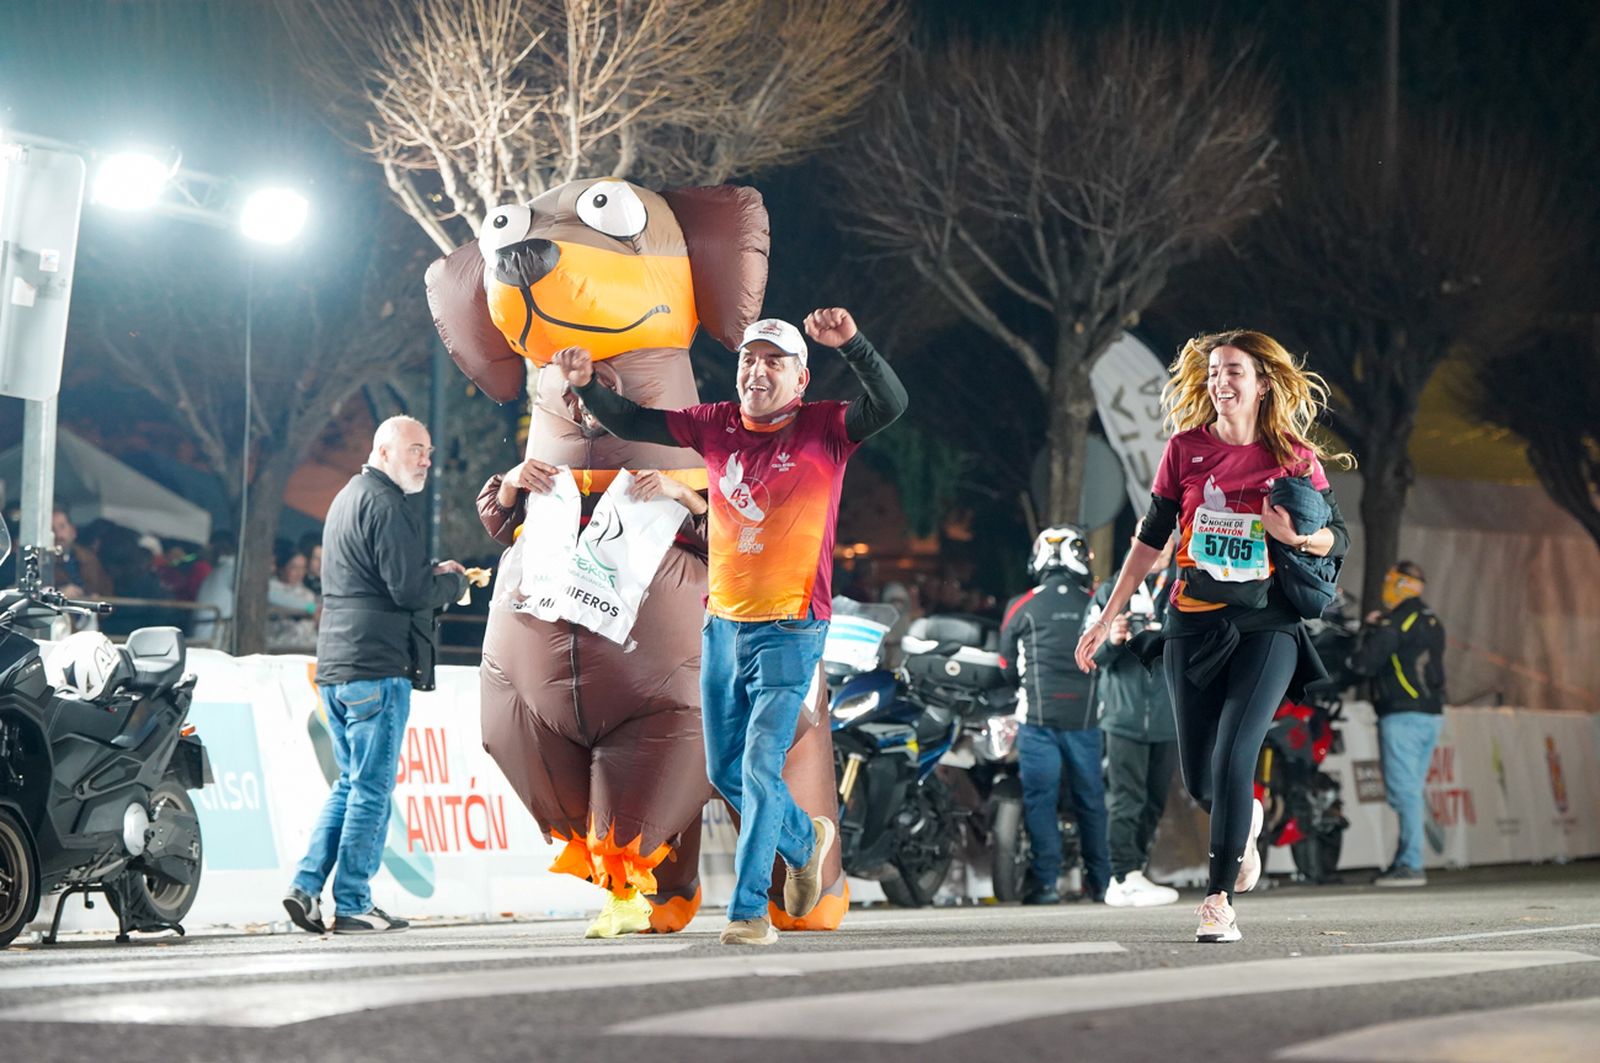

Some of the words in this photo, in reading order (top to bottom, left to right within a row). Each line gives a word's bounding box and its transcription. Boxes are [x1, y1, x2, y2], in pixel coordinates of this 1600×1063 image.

[730, 488, 750, 508] 43
[1208, 519, 1233, 528] NOCHE
[1234, 521, 1244, 529] DE
[1215, 527, 1244, 536] ANTÓN
[1204, 534, 1254, 561] 5765
[407, 776, 509, 853] ANTÓN
